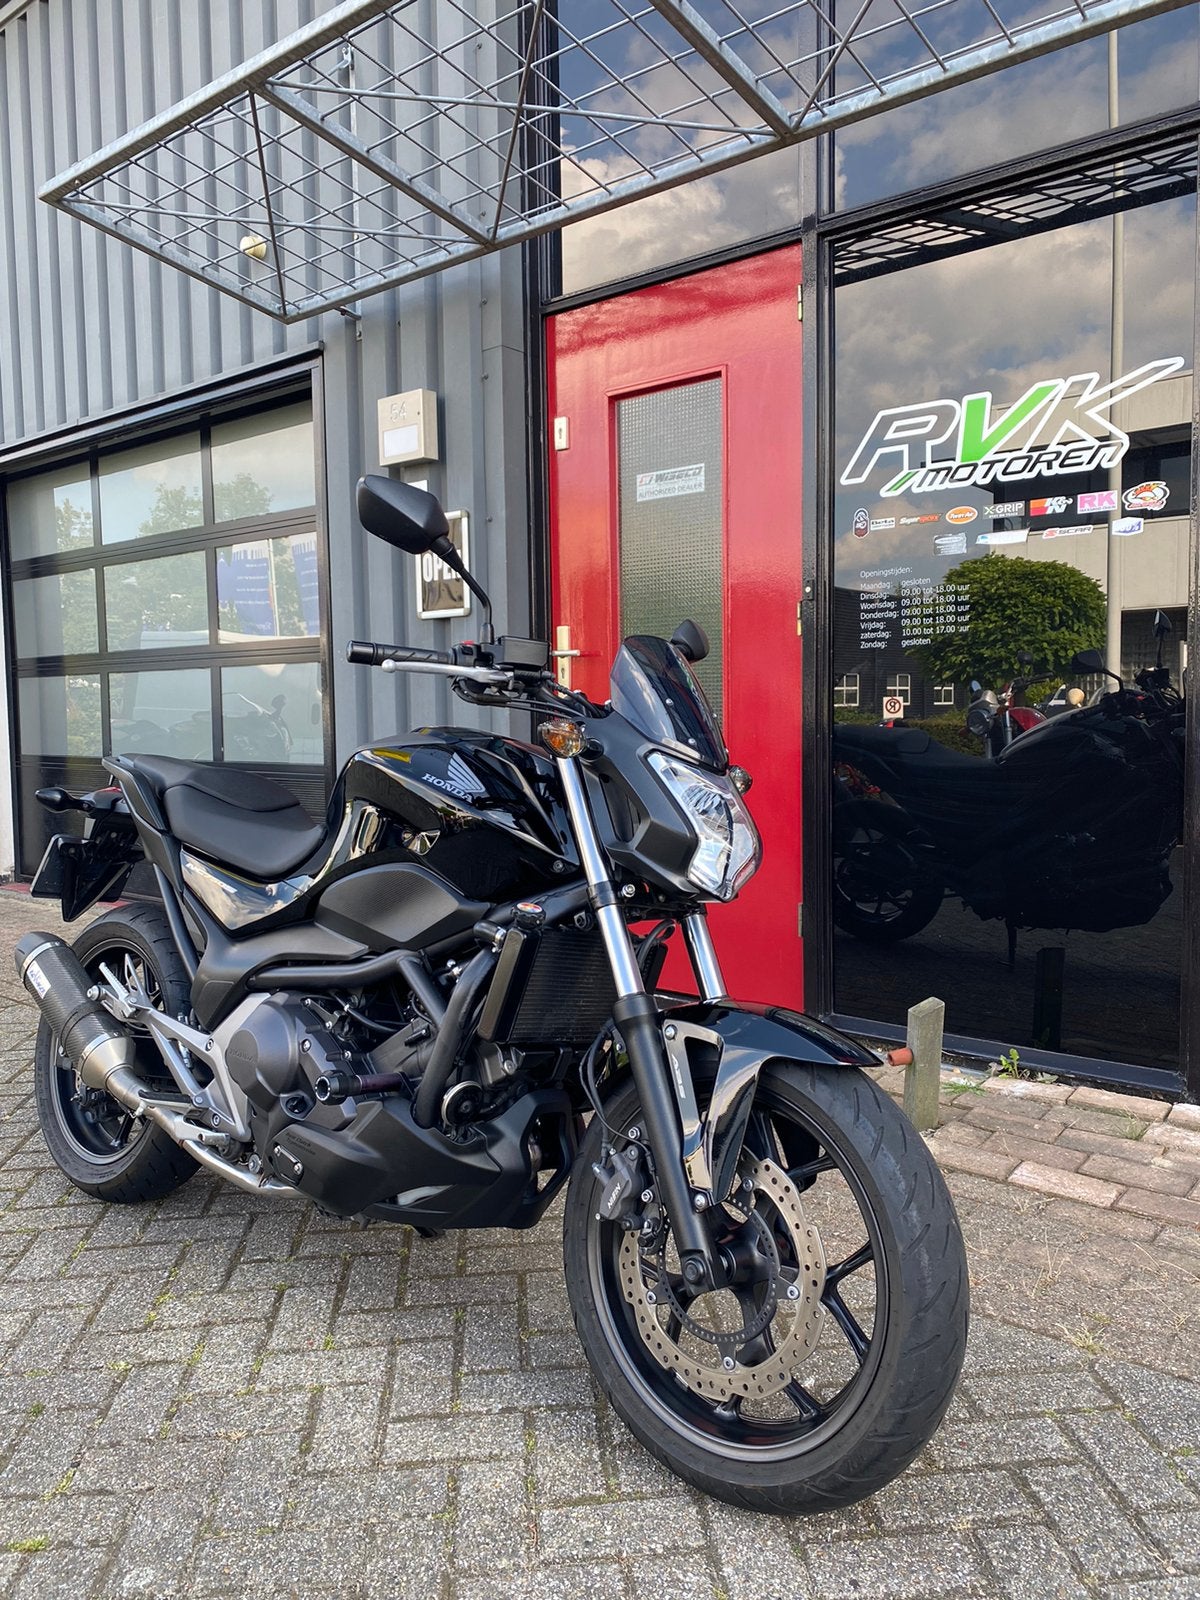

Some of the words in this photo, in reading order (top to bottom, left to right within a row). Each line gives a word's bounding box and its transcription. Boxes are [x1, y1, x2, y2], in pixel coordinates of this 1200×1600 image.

[390, 402, 406, 422] 54
[840, 356, 1185, 486] RVK
[677, 482, 703, 492] DEALER
[1045, 496, 1073, 514] K&N
[1080, 492, 1115, 508] RK
[984, 502, 1024, 515] X-GRIP
[860, 567, 913, 579] Openingstijden:
[860, 581, 892, 590] Maandag:
[901, 577, 931, 587] gesloten
[860, 592, 890, 601] Dinsdag:
[901, 588, 921, 596] 09.00
[922, 586, 934, 594] tot
[935, 584, 956, 593] 18.00
[860, 600, 898, 610] Woensdag:
[901, 598, 921, 606] 09.00
[922, 596, 934, 604] tot
[935, 594, 956, 604] 18.00
[957, 594, 970, 602] uur
[860, 610, 900, 620] Donderdag:
[901, 608, 921, 617] 09.00
[922, 607, 934, 615] tot
[935, 605, 956, 614] 18.00
[957, 604, 970, 612] uur
[860, 621, 887, 631] Vrijdag:
[901, 618, 921, 626] 09.00
[922, 617, 934, 625] tot
[935, 614, 956, 624] 18.00
[860, 630, 892, 640] zaterdag:
[901, 628, 921, 636] 10.00
[922, 626, 934, 634] tot
[935, 625, 956, 634] 17.00
[860, 641, 888, 650] Zondag:
[901, 638, 932, 648] gesloten
[421, 773, 473, 803] HONDA
